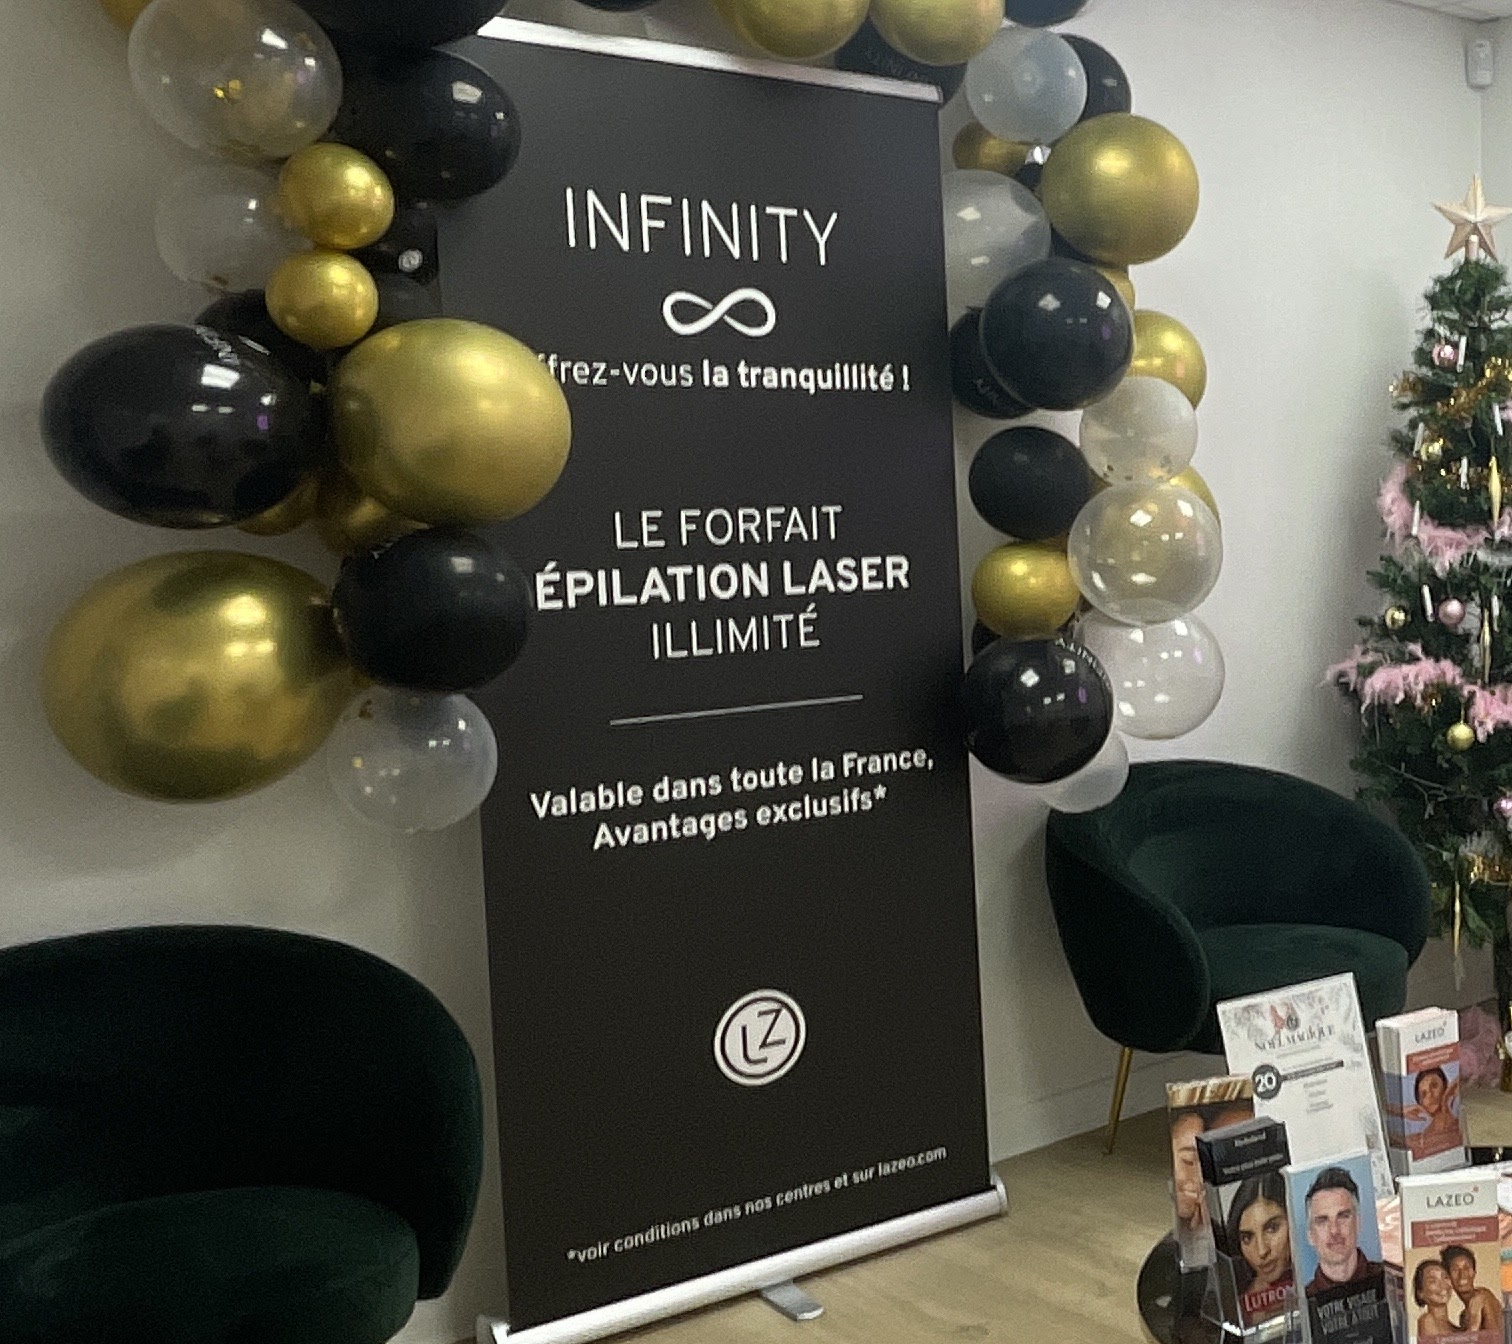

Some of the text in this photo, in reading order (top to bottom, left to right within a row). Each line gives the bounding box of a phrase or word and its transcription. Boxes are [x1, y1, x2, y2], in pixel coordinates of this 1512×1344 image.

[566, 186, 838, 265] INFINITY
[537, 353, 910, 394] frez-vous la tranquillité !
[613, 504, 843, 550] LE FORFAIT
[535, 555, 910, 611] ÉPILATION LASER
[651, 604, 821, 660] ILLIMITÉ
[530, 748, 934, 820] Valable dans toute la France,
[593, 808, 748, 851] Avantages
[614, 1217, 700, 1253] conditions
[703, 1205, 742, 1227] dans
[745, 1196, 773, 1216] nos
[775, 1179, 831, 1207] centres
[834, 1172, 849, 1190] et
[852, 1166, 875, 1184] sur
[878, 1147, 947, 1177] lazeo.com
[1426, 1192, 1475, 1209] LAZEO
